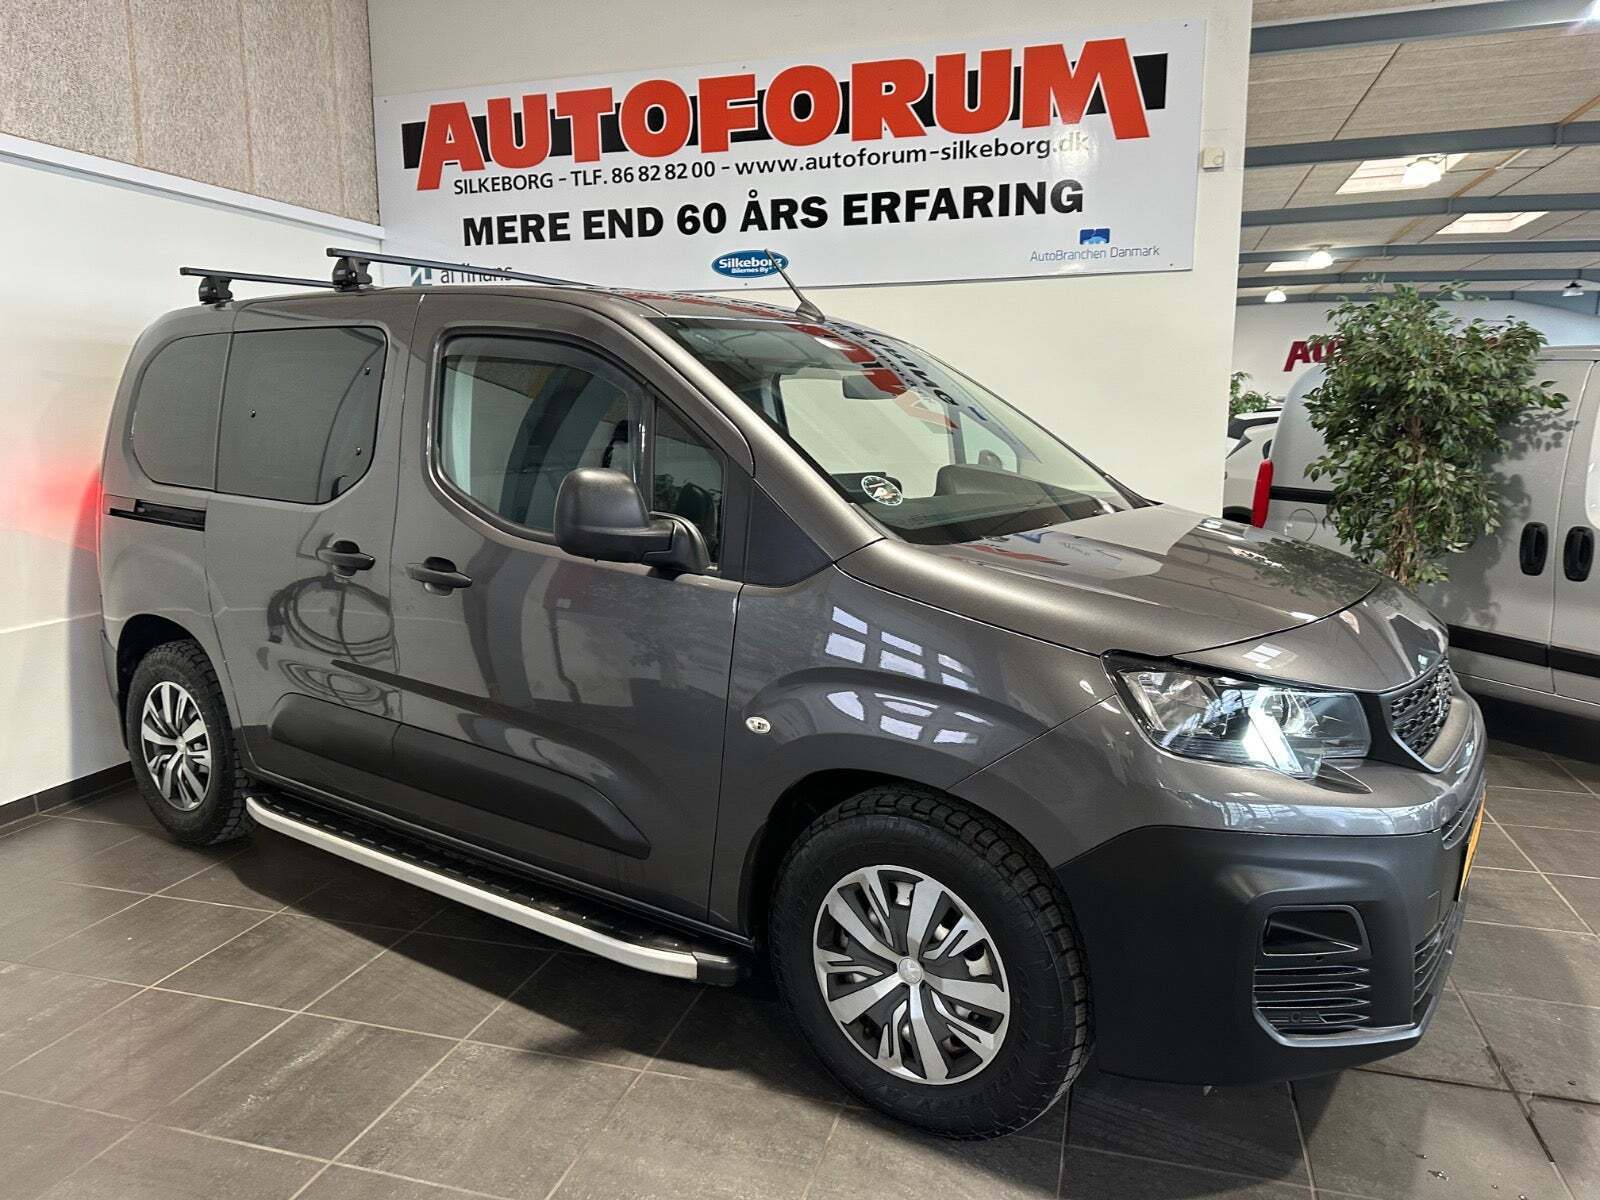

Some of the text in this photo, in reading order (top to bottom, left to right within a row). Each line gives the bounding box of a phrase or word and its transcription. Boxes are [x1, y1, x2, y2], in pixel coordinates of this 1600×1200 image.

[417, 37, 1150, 191] AUTOFORUM
[453, 172, 553, 195] SILKEBORG
[570, 169, 608, 187] TLF.
[611, 166, 635, 184] 86
[638, 164, 661, 182] 82
[664, 162, 688, 180] 82
[691, 160, 716, 178] 00
[735, 131, 1089, 175] www.autoforum-silkeborg.dk
[462, 178, 1084, 247] MERE END 60 ÅRS ERFARING
[1030, 245, 1160, 262] AutoBranchen Danmark
